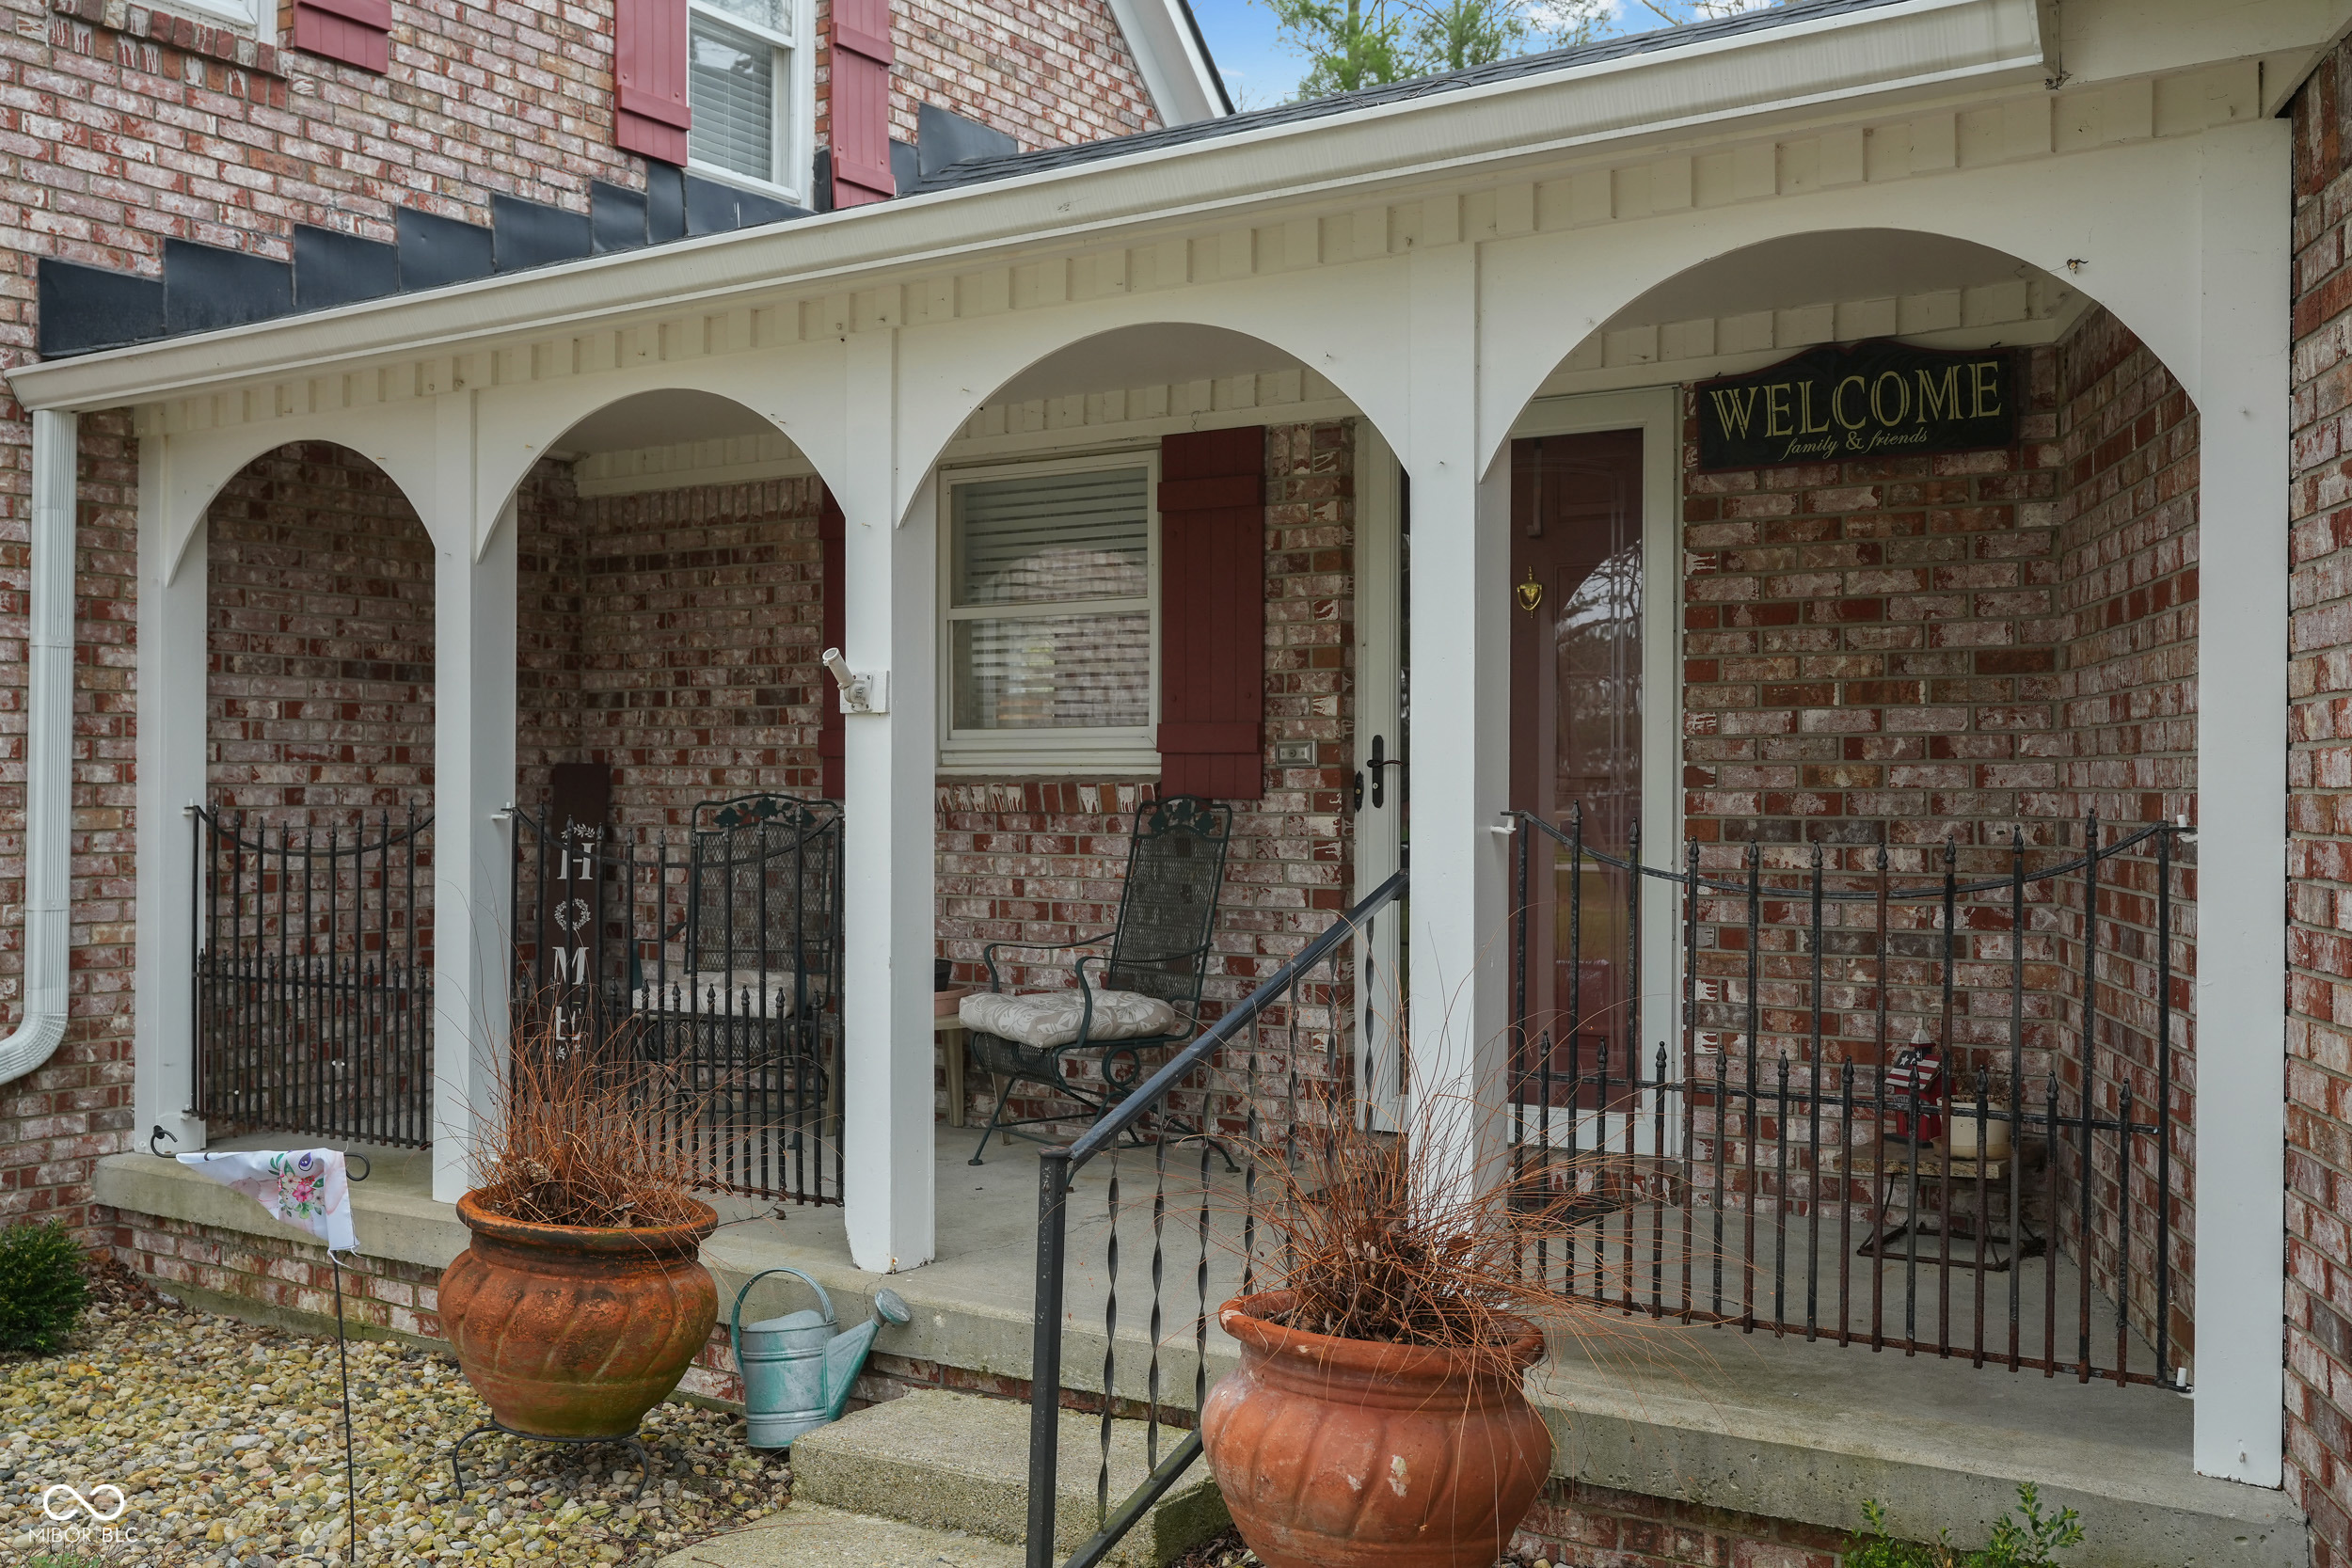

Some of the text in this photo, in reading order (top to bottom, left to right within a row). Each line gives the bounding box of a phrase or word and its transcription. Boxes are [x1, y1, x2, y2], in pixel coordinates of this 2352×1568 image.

[1708, 360, 2002, 441] WELCOME
[1778, 426, 1928, 462] family & friends
